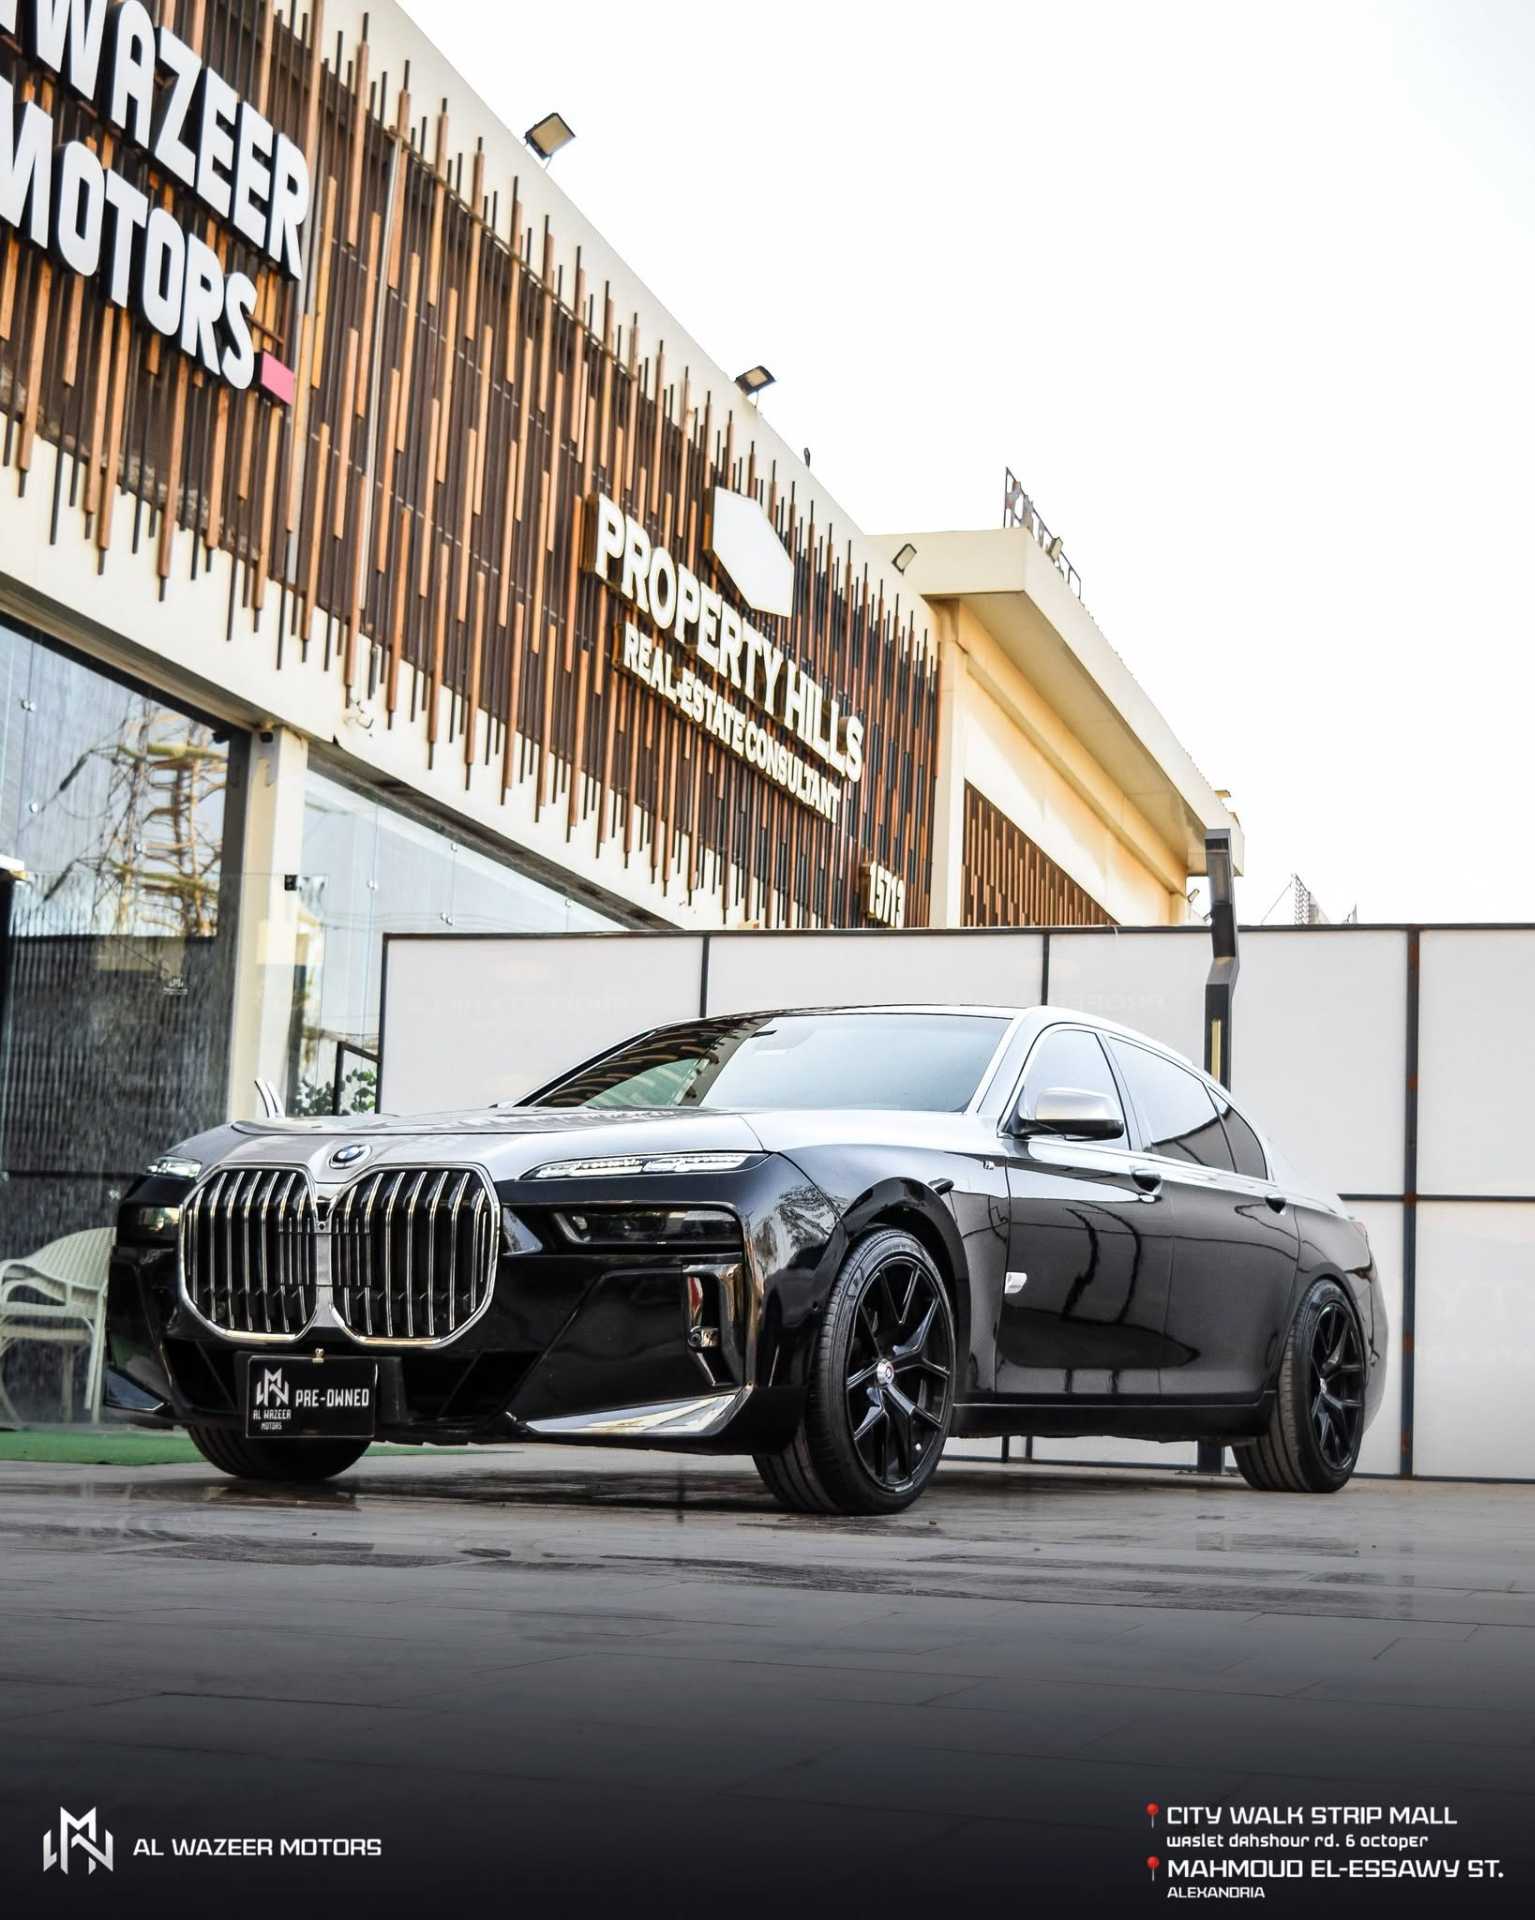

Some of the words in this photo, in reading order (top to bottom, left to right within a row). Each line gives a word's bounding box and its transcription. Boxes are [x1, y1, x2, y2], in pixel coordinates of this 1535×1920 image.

[595, 491, 783, 715] PROPERTY
[784, 658, 864, 782] HILLS
[745, 720, 841, 825] CONSULTANT
[295, 1388, 370, 1408] PRE-OWNED
[252, 1409, 262, 1420] AL
[263, 1409, 291, 1420] WAZEER
[261, 1422, 282, 1430] MOTORS
